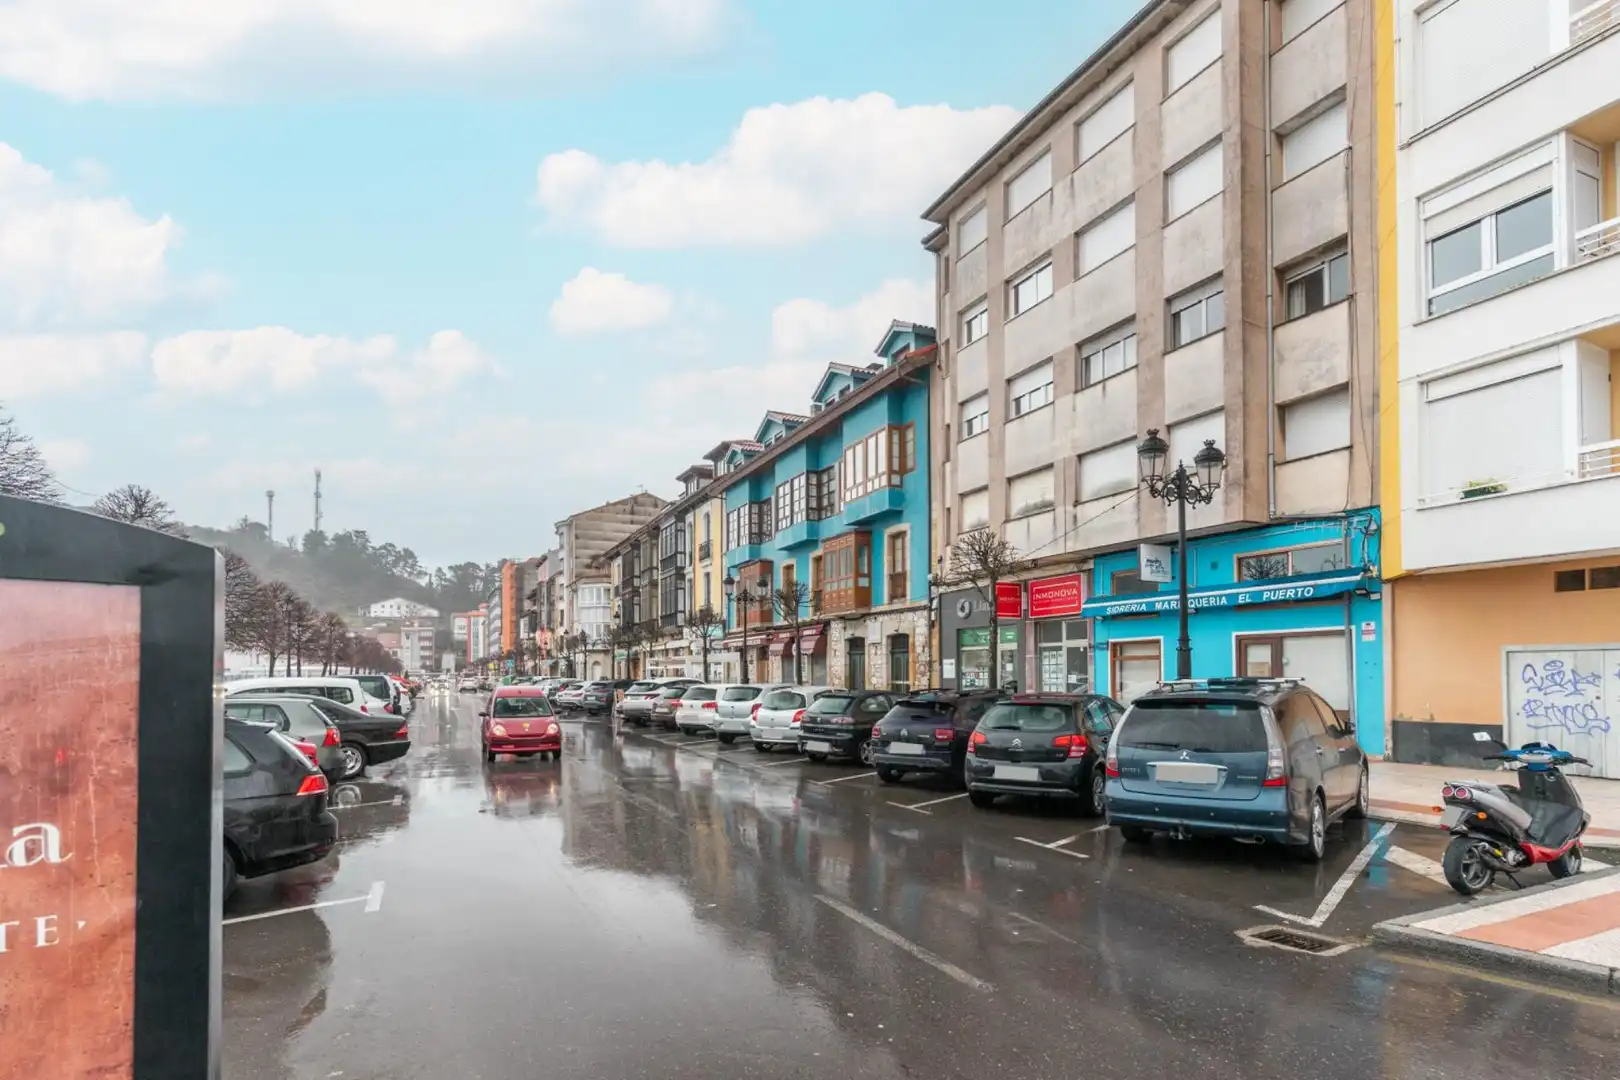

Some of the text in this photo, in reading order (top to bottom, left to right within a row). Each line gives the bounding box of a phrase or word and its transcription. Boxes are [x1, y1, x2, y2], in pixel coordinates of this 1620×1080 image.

[1033, 588, 1078, 600] INMONOVA
[1106, 587, 1314, 615] SIDRERIA MARIQUERIA EL PUERTO
[0, 822, 74, 867] a
